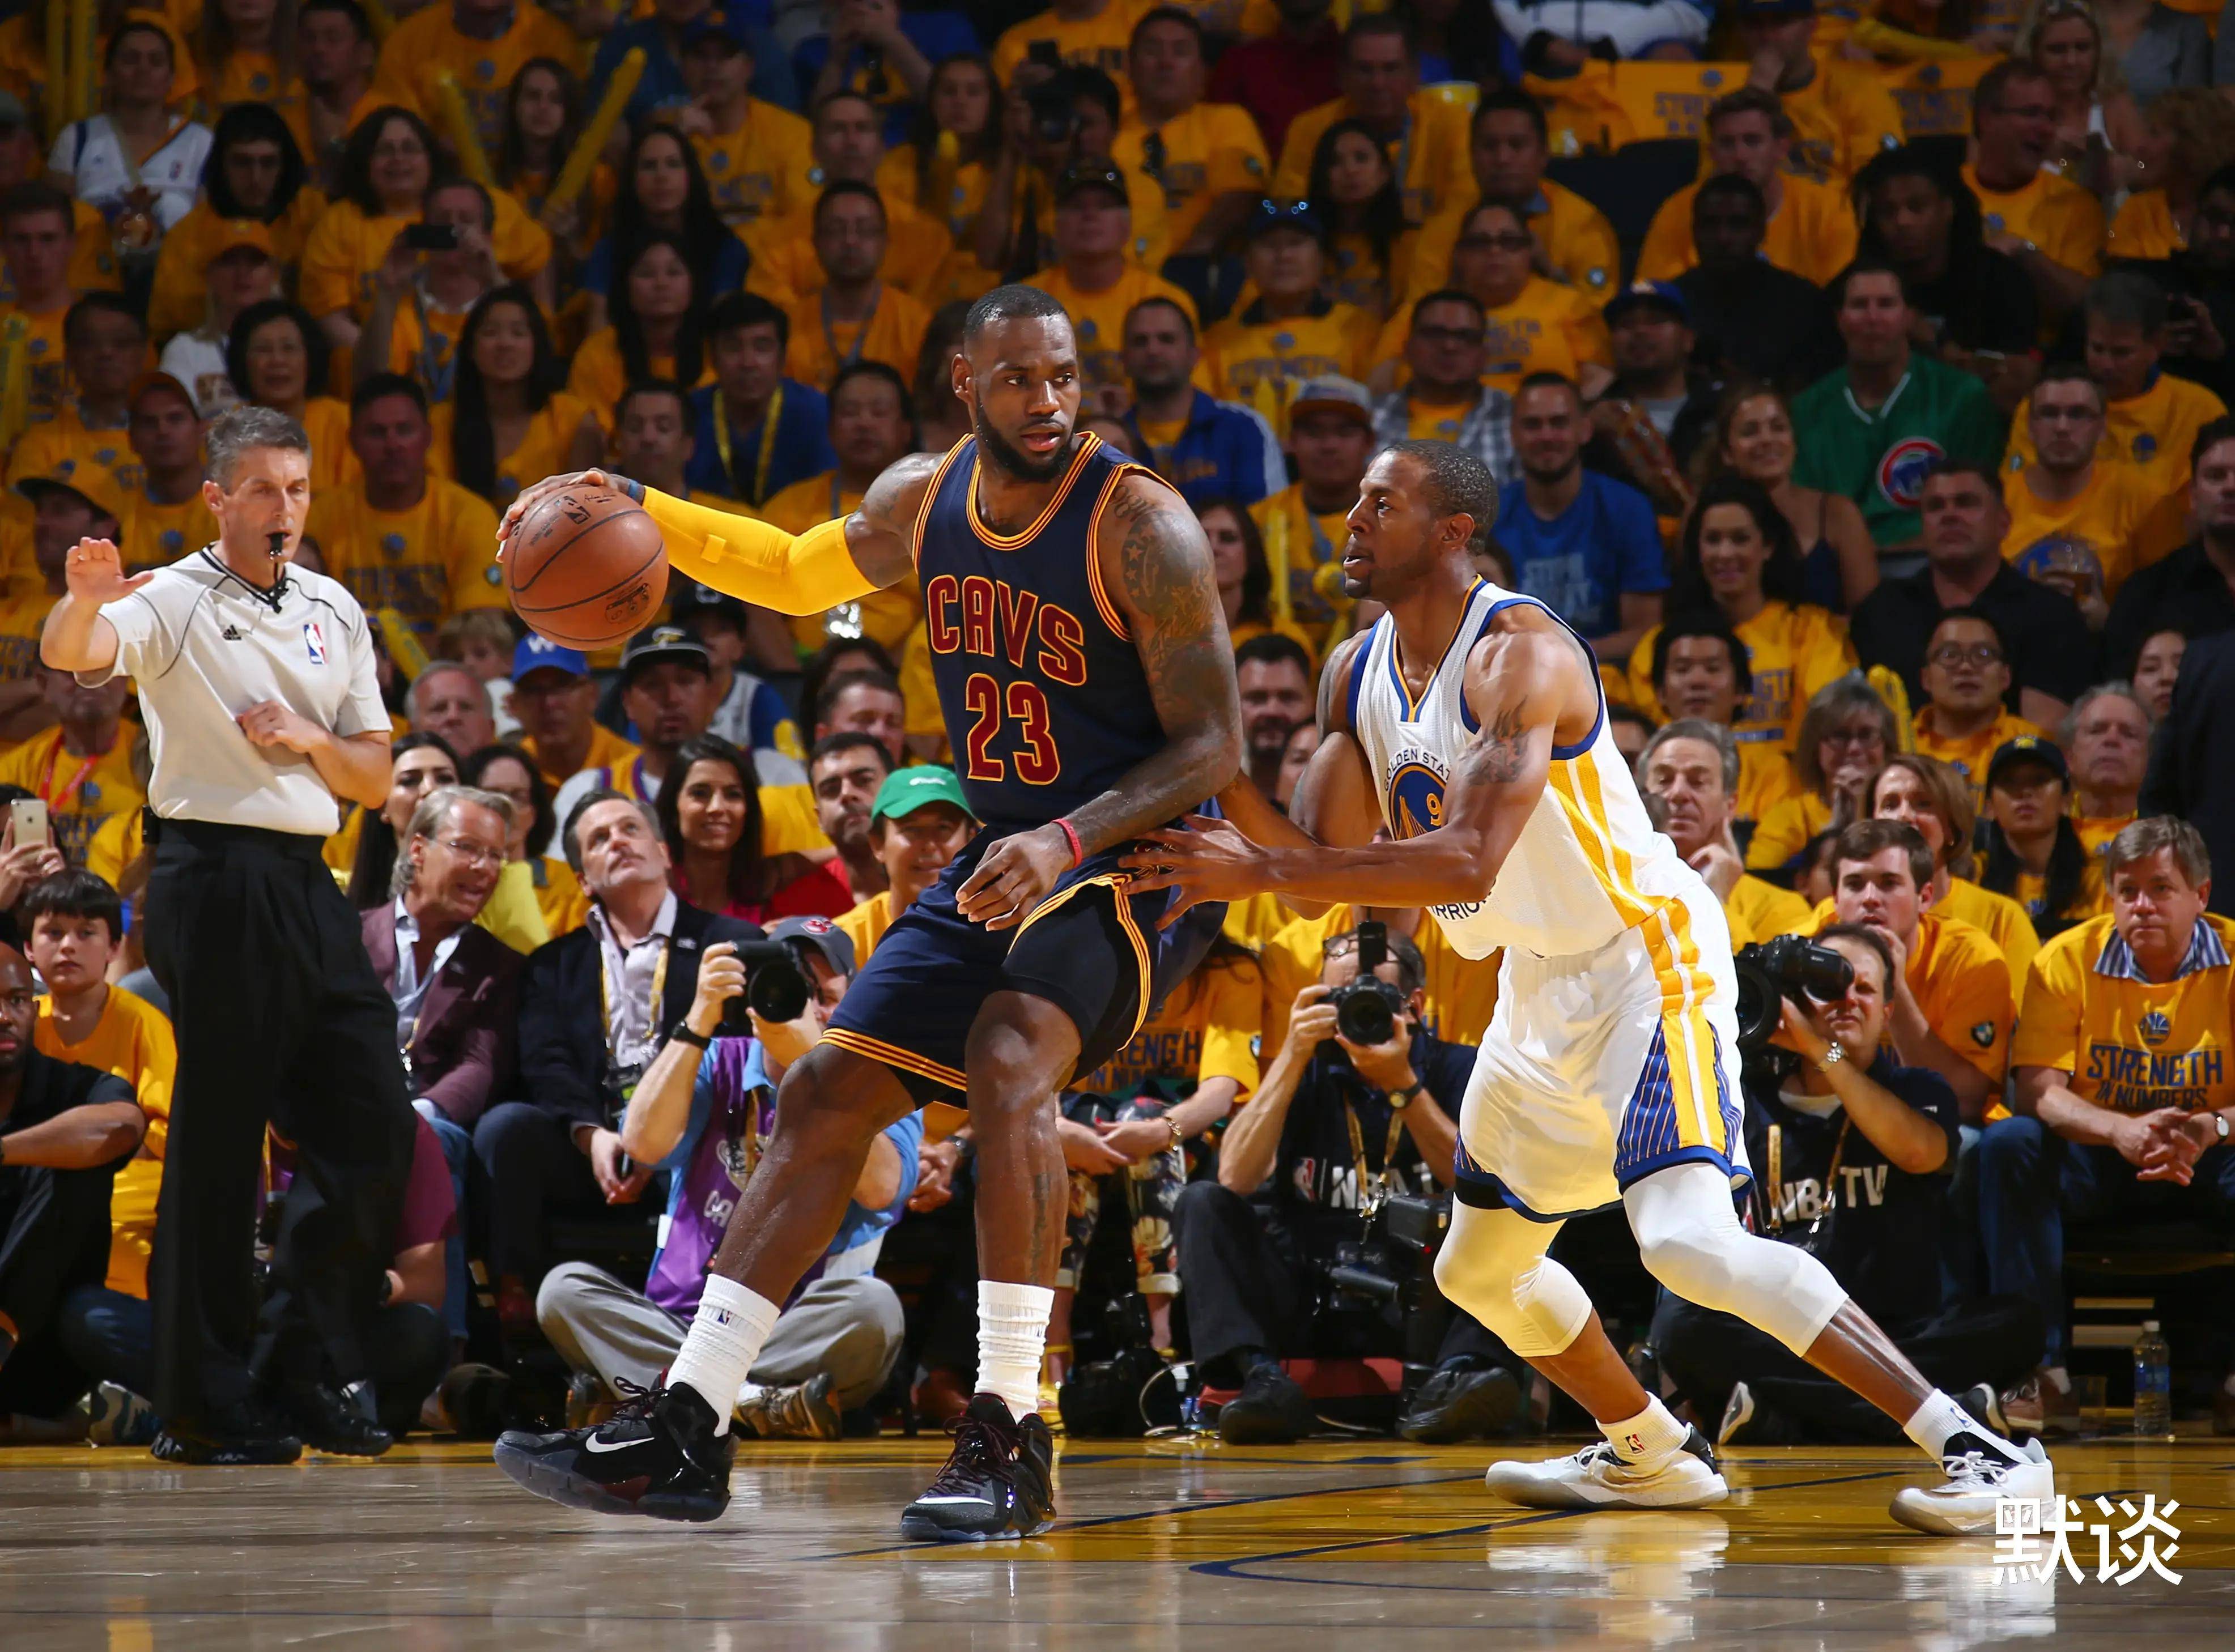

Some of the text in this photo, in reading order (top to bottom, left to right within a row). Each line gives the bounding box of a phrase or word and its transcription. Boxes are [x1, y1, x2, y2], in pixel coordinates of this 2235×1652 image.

[928, 574, 1087, 686] CAVS
[966, 672, 1060, 785] 23
[1384, 748, 1450, 791] GOLDEN STAT
[1426, 793, 1442, 826] 9
[2087, 1044, 2223, 1087] STRENGTH
[2115, 1083, 2208, 1110] NUMBERS
[1839, 1164, 1889, 1209] TV
